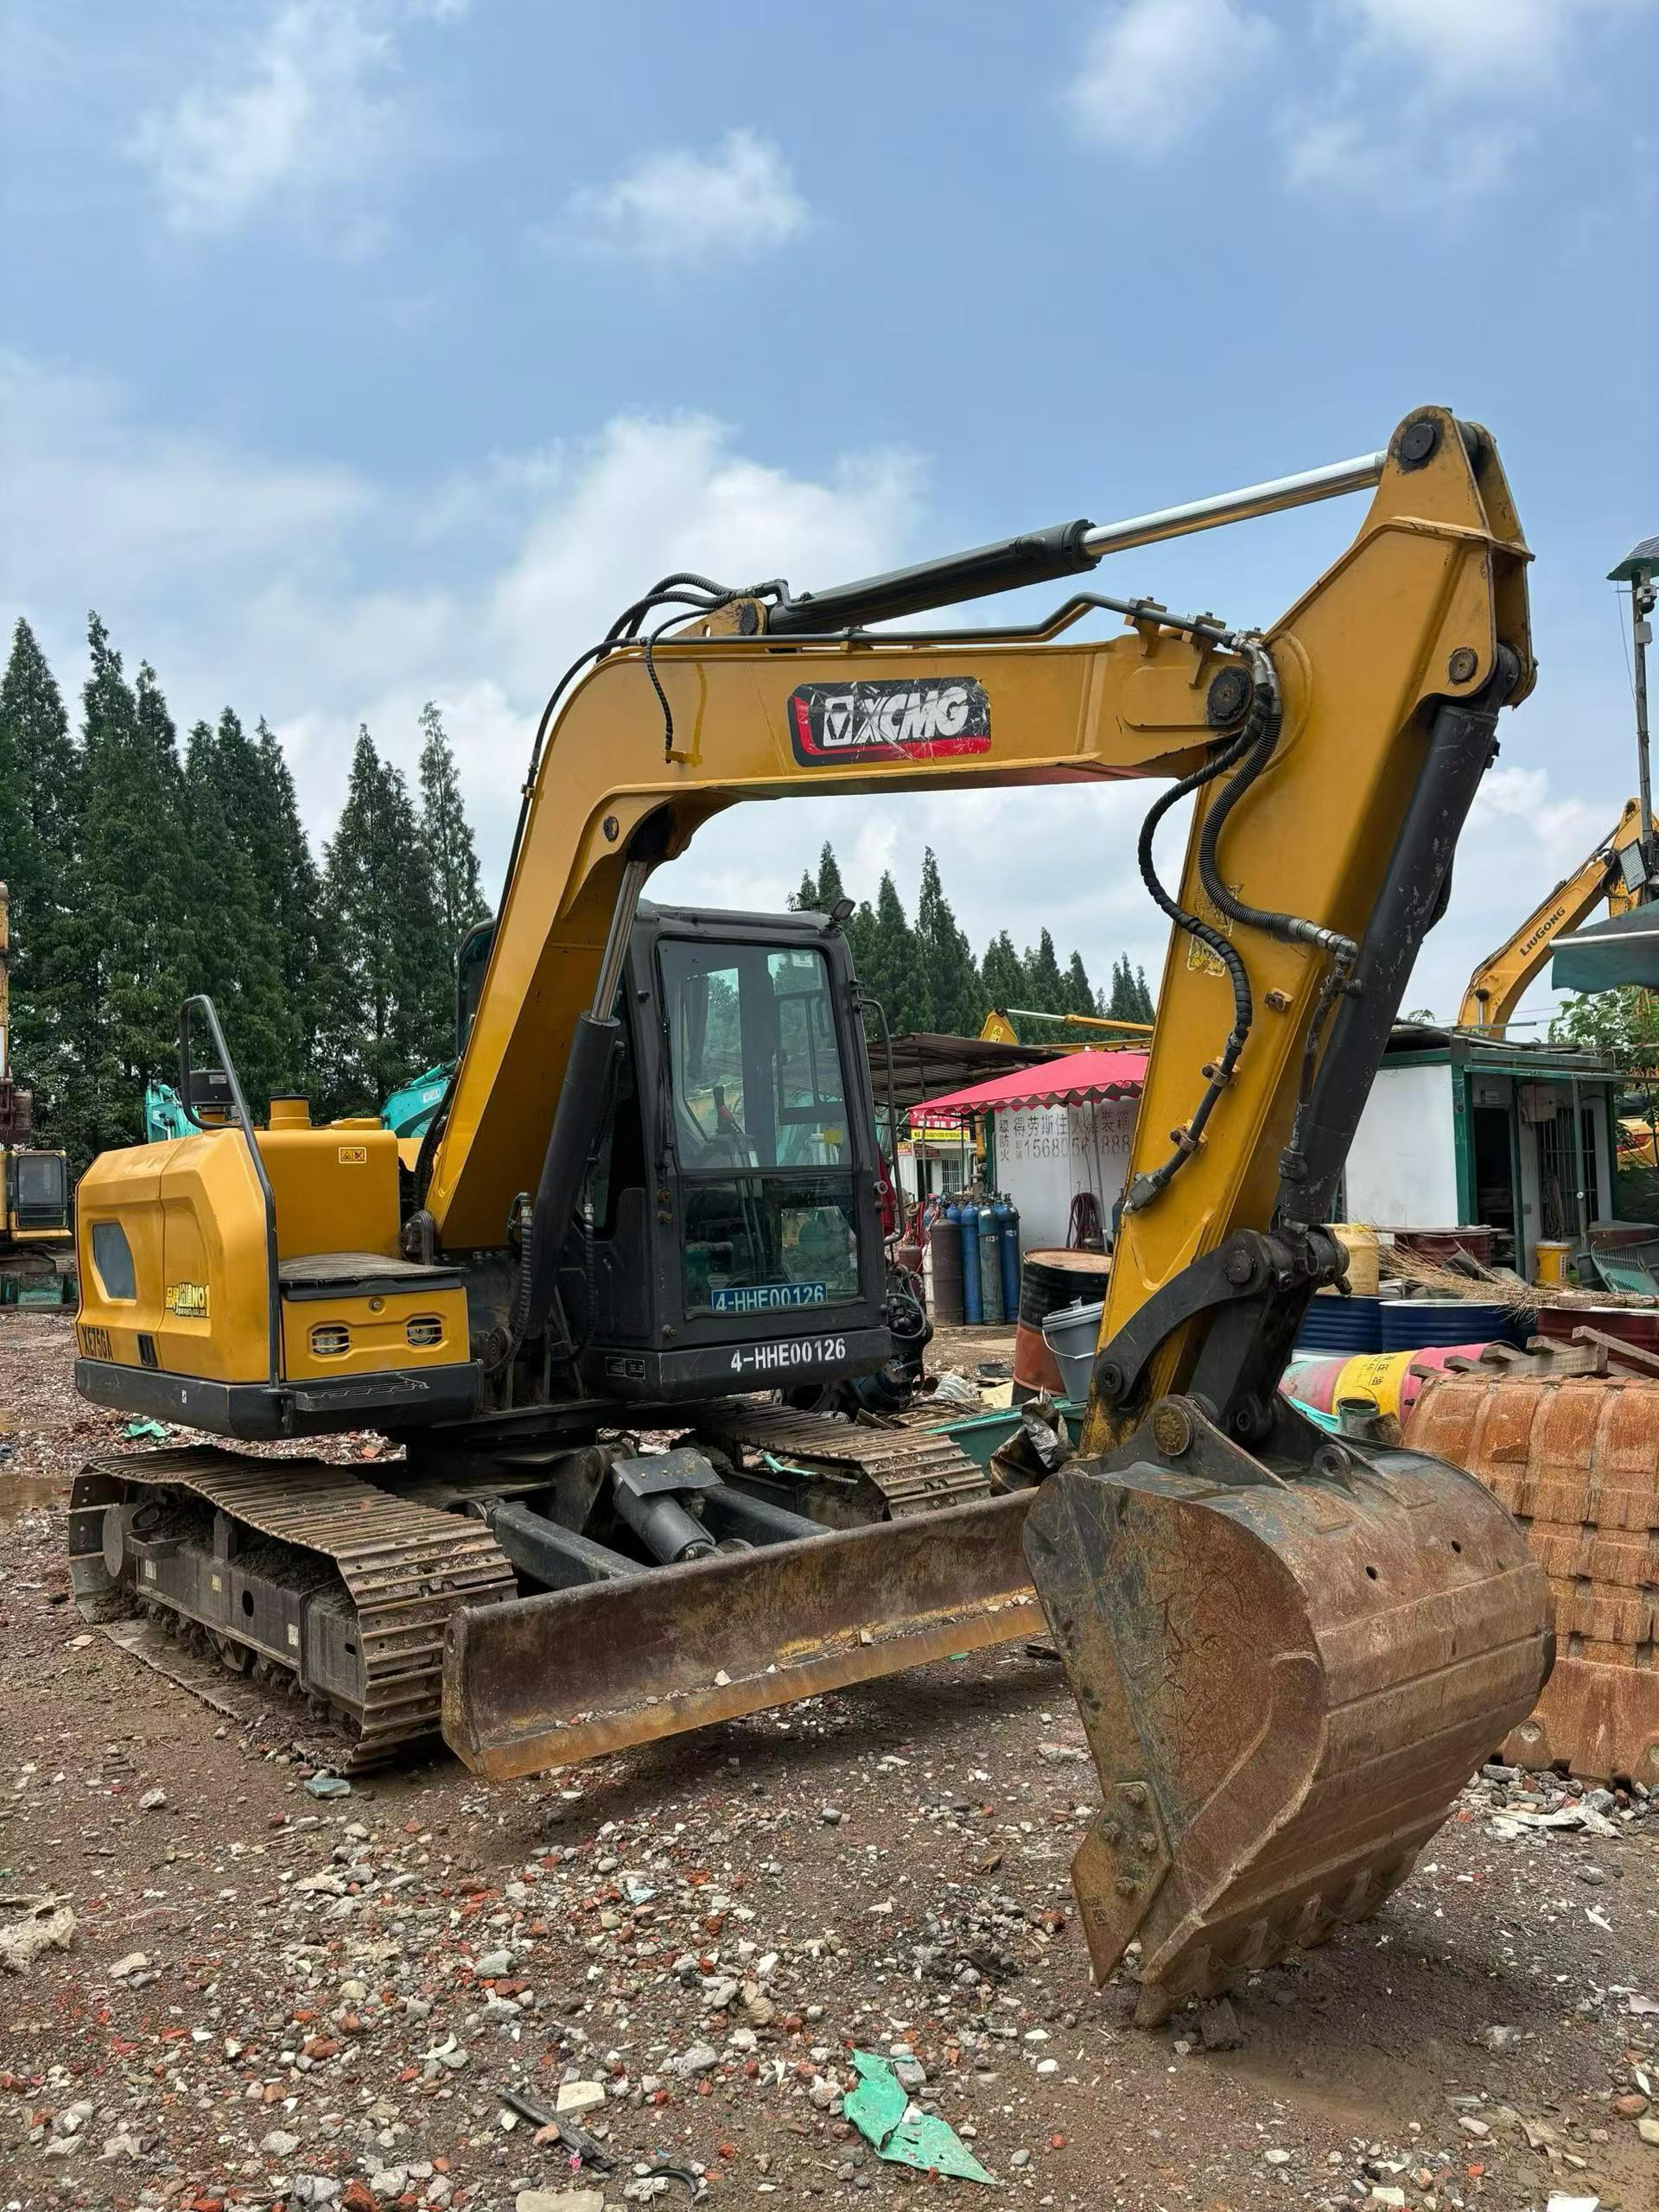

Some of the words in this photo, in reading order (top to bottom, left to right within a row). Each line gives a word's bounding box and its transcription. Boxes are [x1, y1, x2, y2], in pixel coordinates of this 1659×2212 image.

[852, 687, 969, 744] XCMG
[1520, 906, 1566, 956] LIUGONG
[999, 1111, 1010, 1162] 级防火
[715, 1285, 823, 1312] 4-HHE00126
[81, 1326, 113, 1360] XE75GA
[731, 1338, 846, 1372] 4-HHE00126
